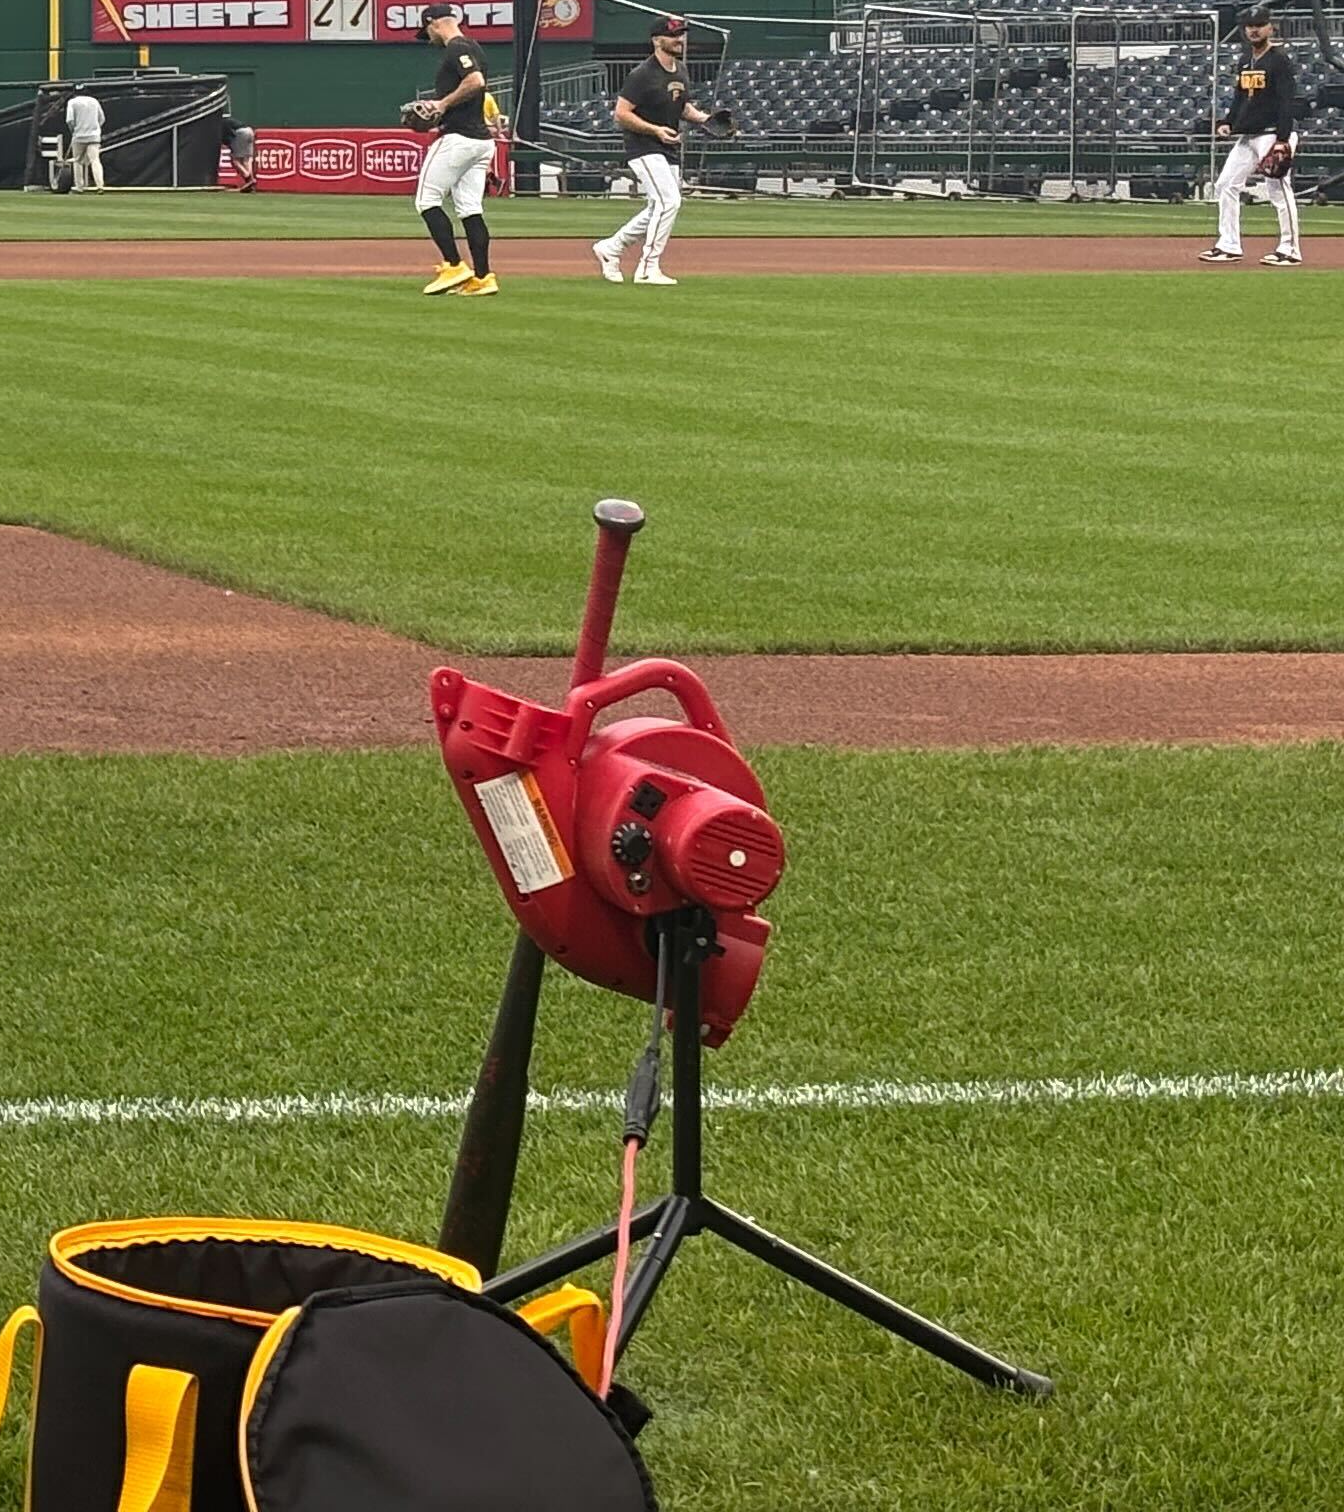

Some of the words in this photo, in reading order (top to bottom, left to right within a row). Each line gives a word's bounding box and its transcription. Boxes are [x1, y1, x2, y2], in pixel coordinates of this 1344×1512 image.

[122, 0, 289, 30] SHEETZ
[386, 1, 514, 29] SHTZ
[255, 149, 292, 170] HEETZ
[303, 149, 354, 170] SHEETZ
[366, 149, 419, 173] SHEETZ
